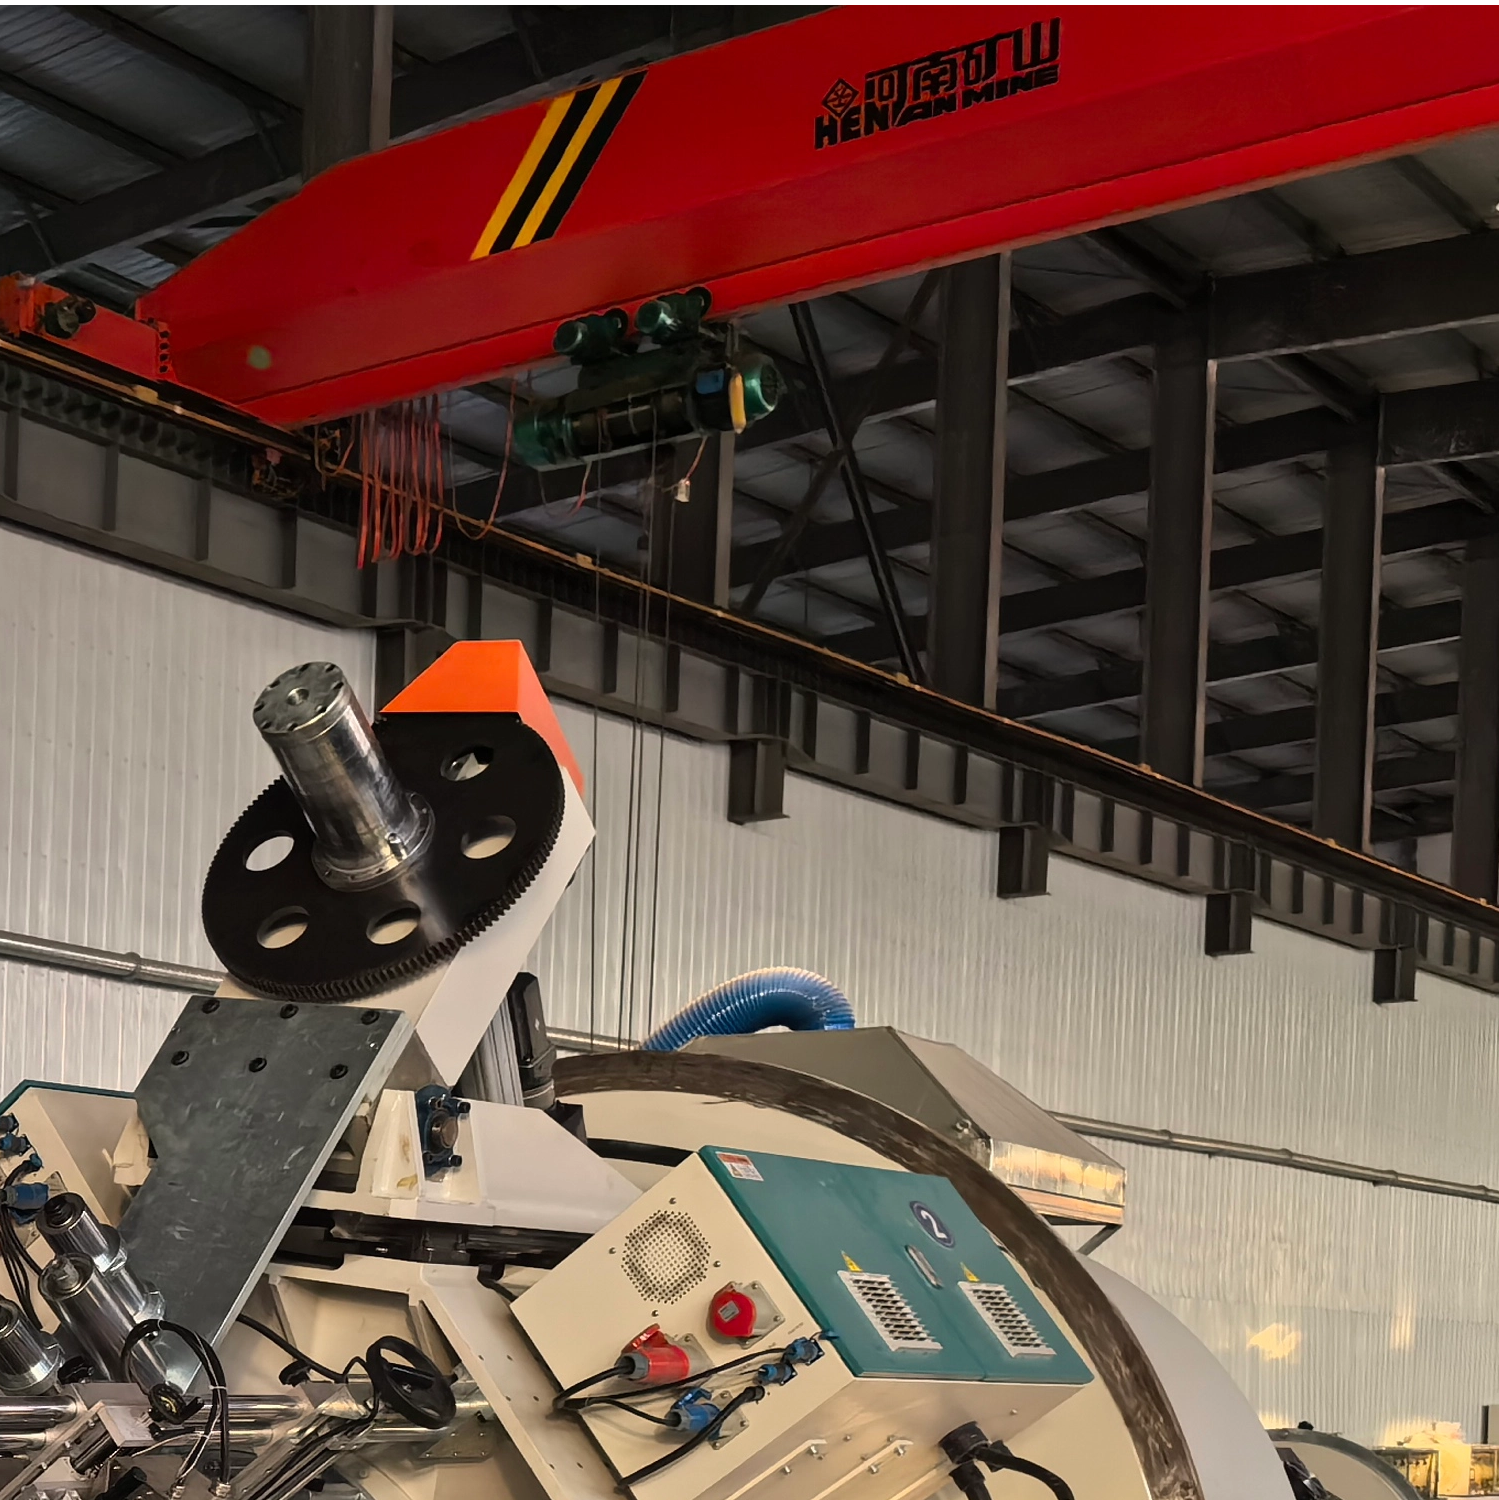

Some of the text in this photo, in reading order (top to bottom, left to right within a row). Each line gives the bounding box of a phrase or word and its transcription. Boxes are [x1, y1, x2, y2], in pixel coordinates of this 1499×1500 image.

[864, 17, 1061, 112] 河南矿山
[962, 64, 1060, 109] MINE
[920, 1209, 947, 1239] 2
